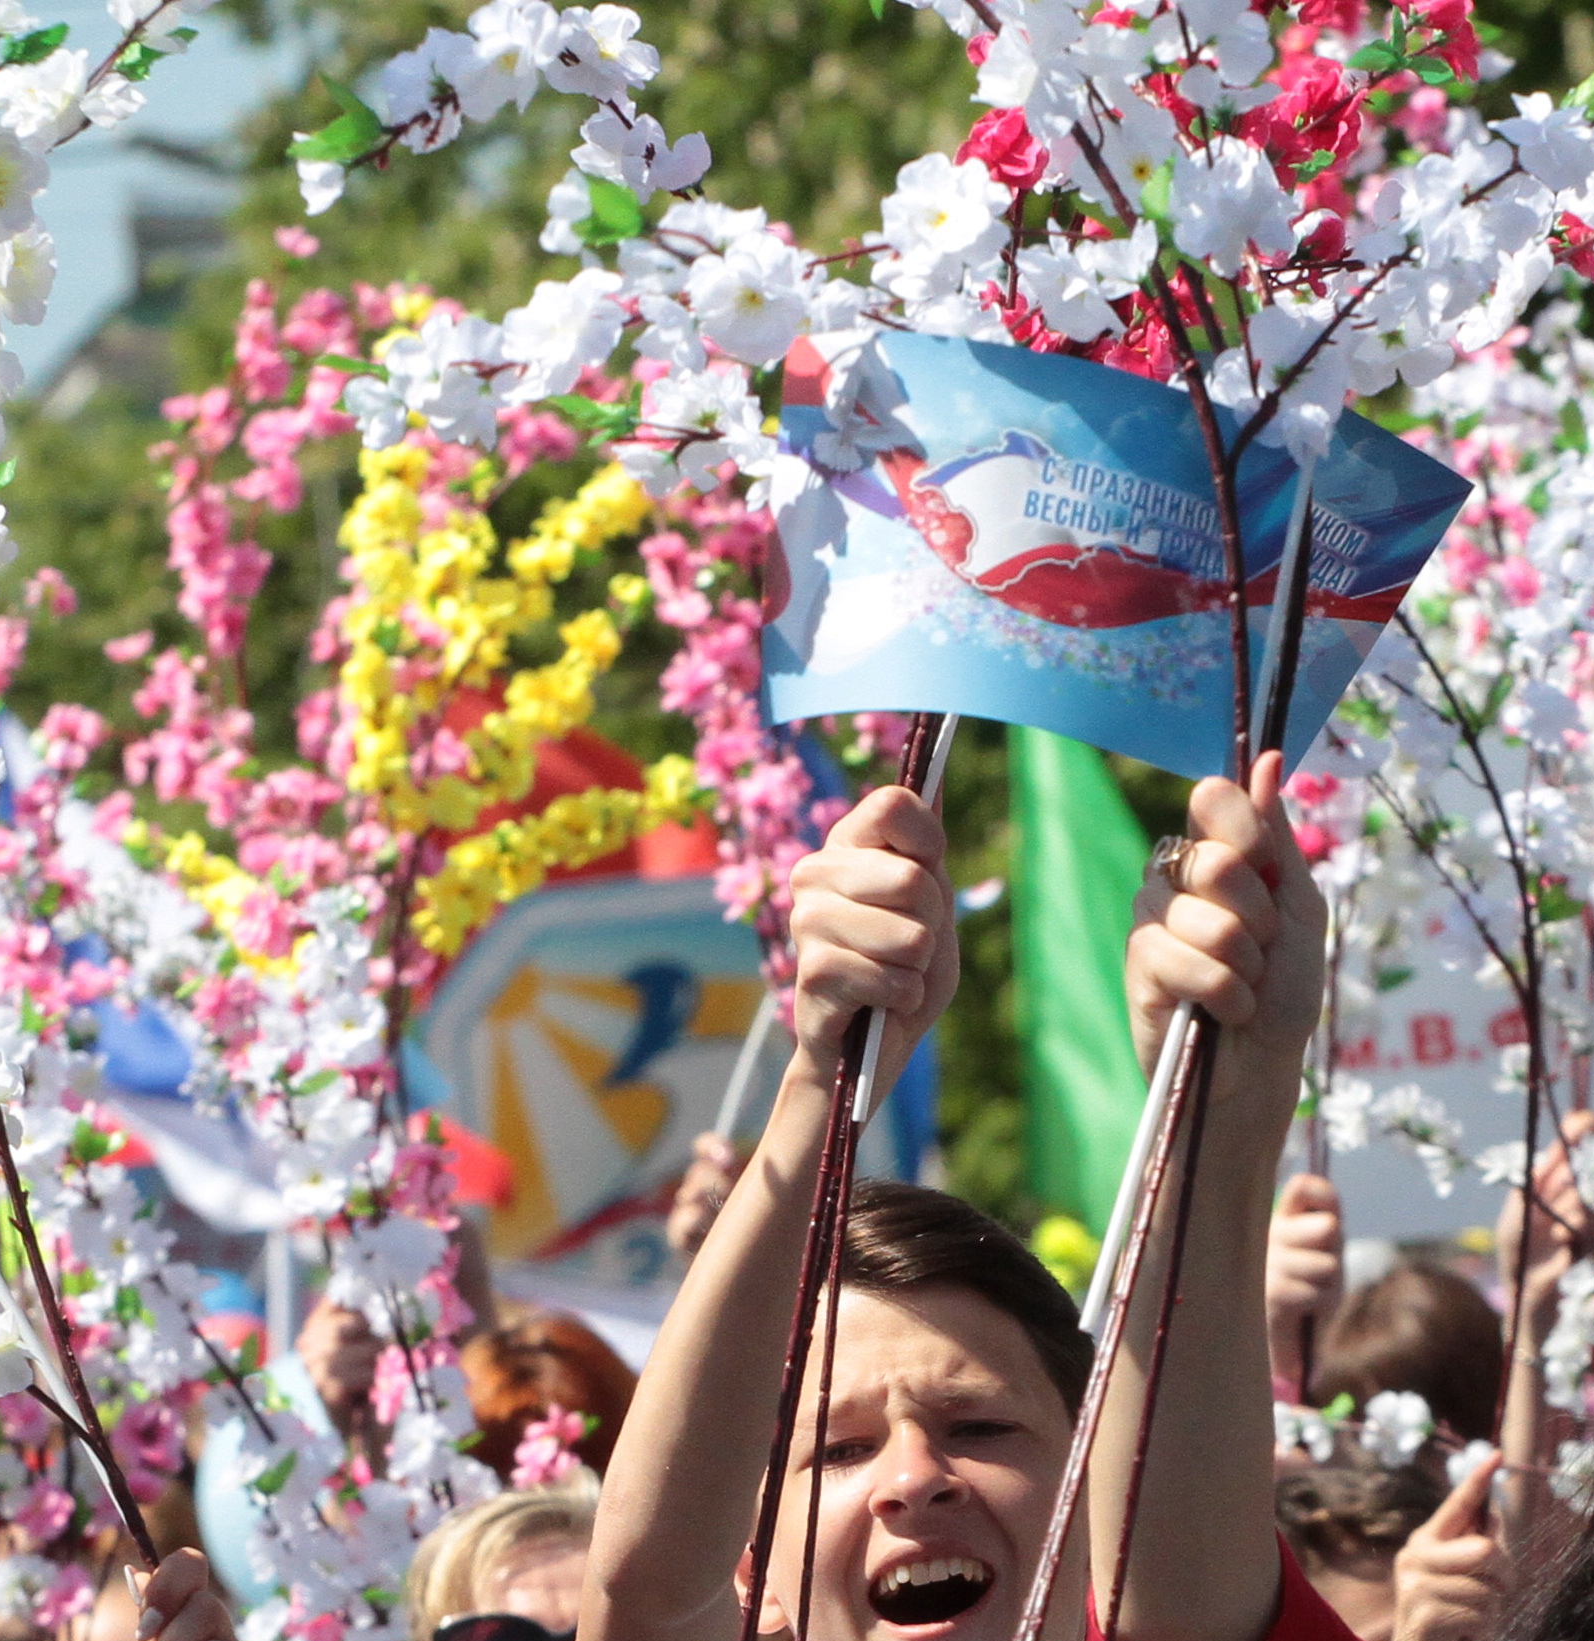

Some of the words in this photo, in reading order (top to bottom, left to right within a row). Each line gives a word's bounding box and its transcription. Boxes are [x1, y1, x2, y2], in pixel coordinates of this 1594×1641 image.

[1041, 456, 1057, 485] С
[1023, 489, 1111, 537] ВЕСНЫ
[1125, 517, 1142, 546] И
[1157, 527, 1226, 582] ТРУДА
